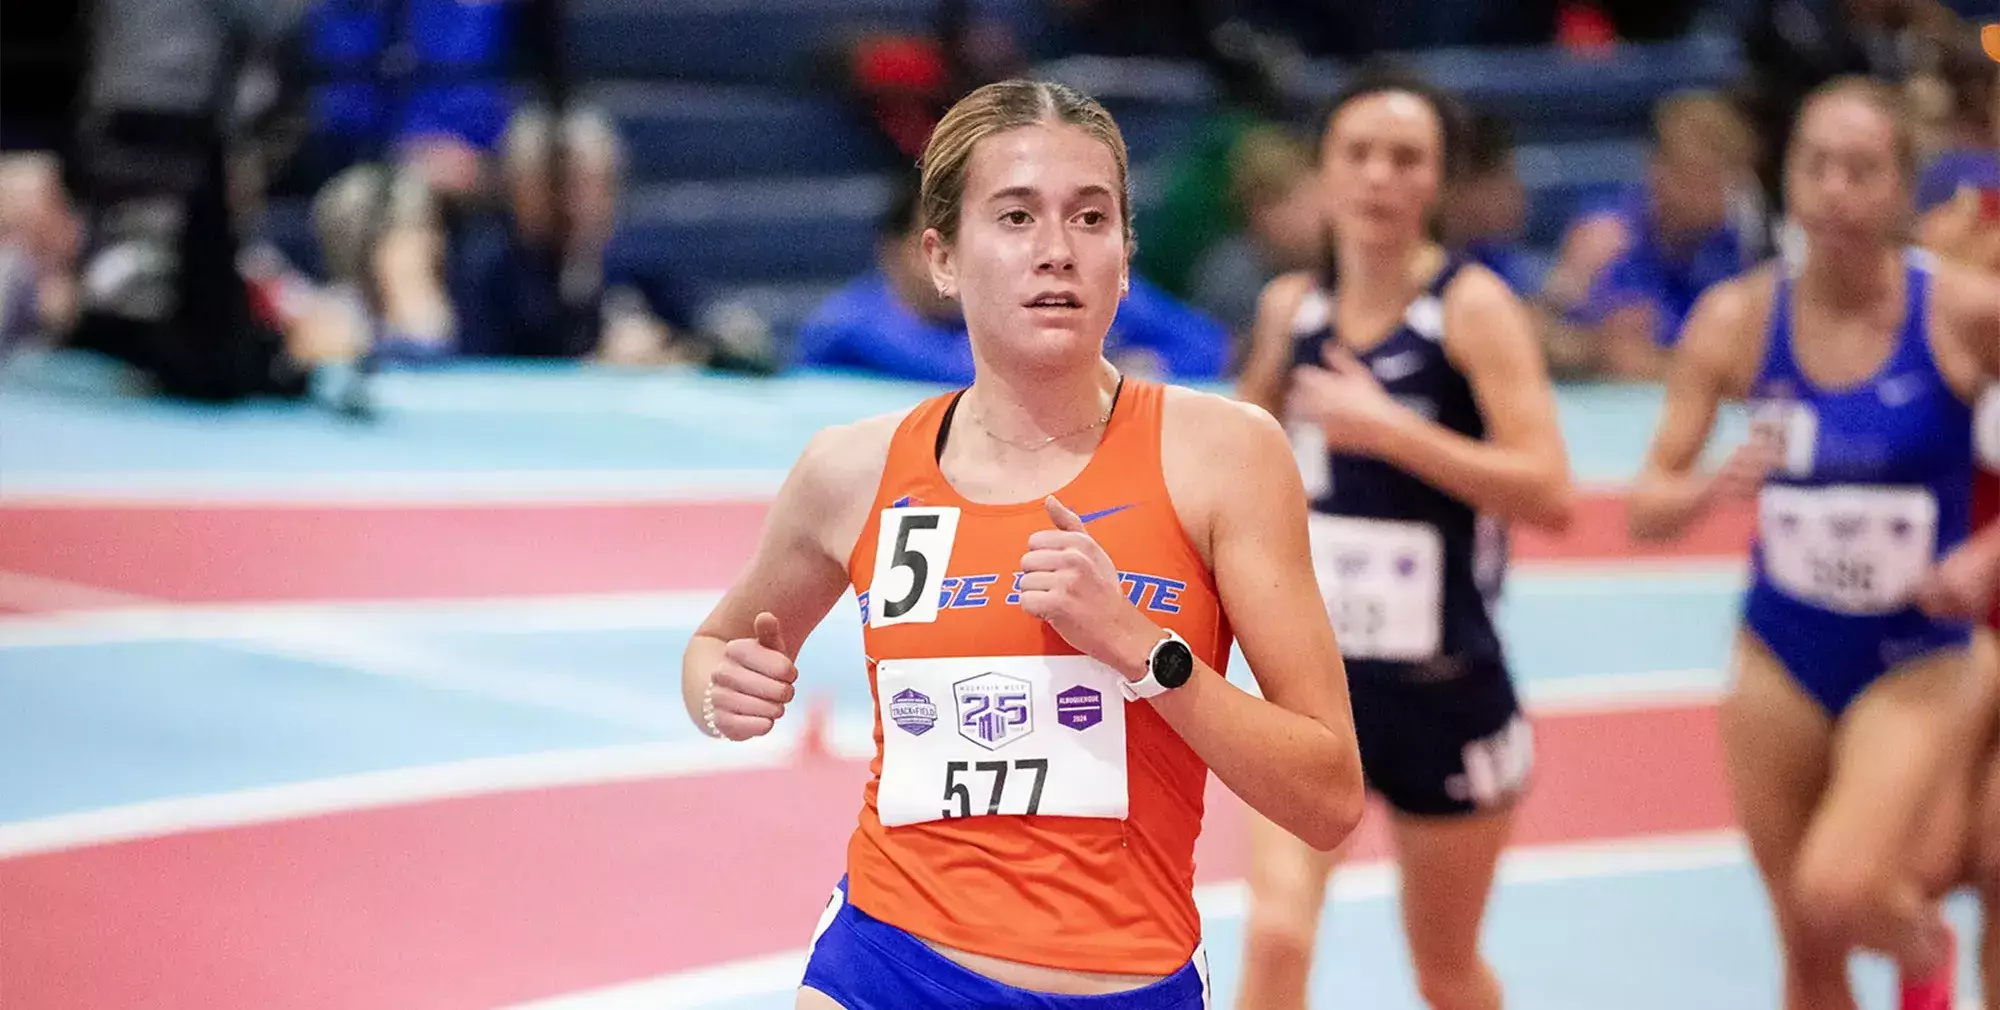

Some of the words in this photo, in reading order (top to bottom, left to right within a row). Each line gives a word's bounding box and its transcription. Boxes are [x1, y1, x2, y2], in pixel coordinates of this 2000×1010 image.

[883, 515, 940, 618] 5
[857, 574, 999, 626] BSE
[962, 694, 1027, 726] 25
[942, 758, 1048, 819] 577
